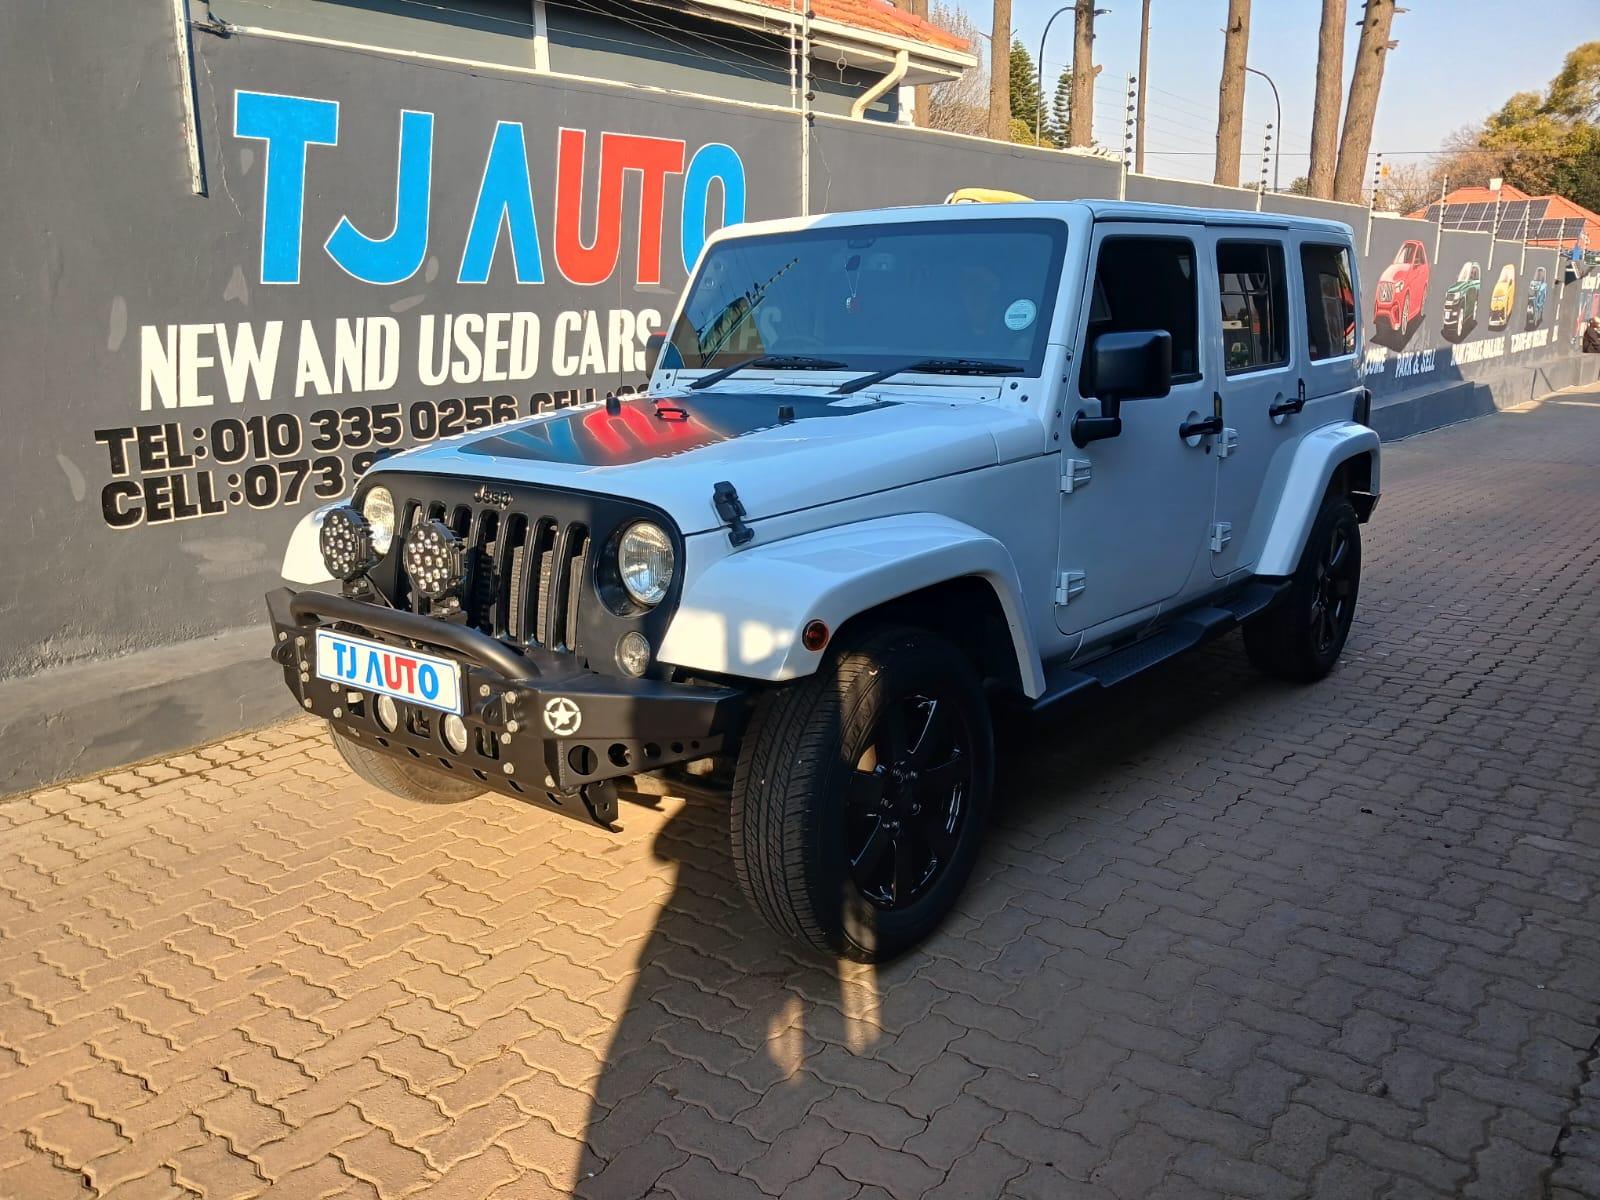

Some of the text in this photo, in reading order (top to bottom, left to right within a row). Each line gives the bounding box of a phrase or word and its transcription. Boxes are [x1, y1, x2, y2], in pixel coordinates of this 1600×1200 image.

[233, 89, 746, 285] TJ AUTO
[140, 319, 283, 411] NEW
[295, 315, 400, 397] AND
[418, 311, 541, 386] USED
[552, 308, 661, 376] CARS
[310, 402, 404, 454] 335
[409, 395, 519, 441] 0256
[332, 641, 439, 700] TJ AUTO
